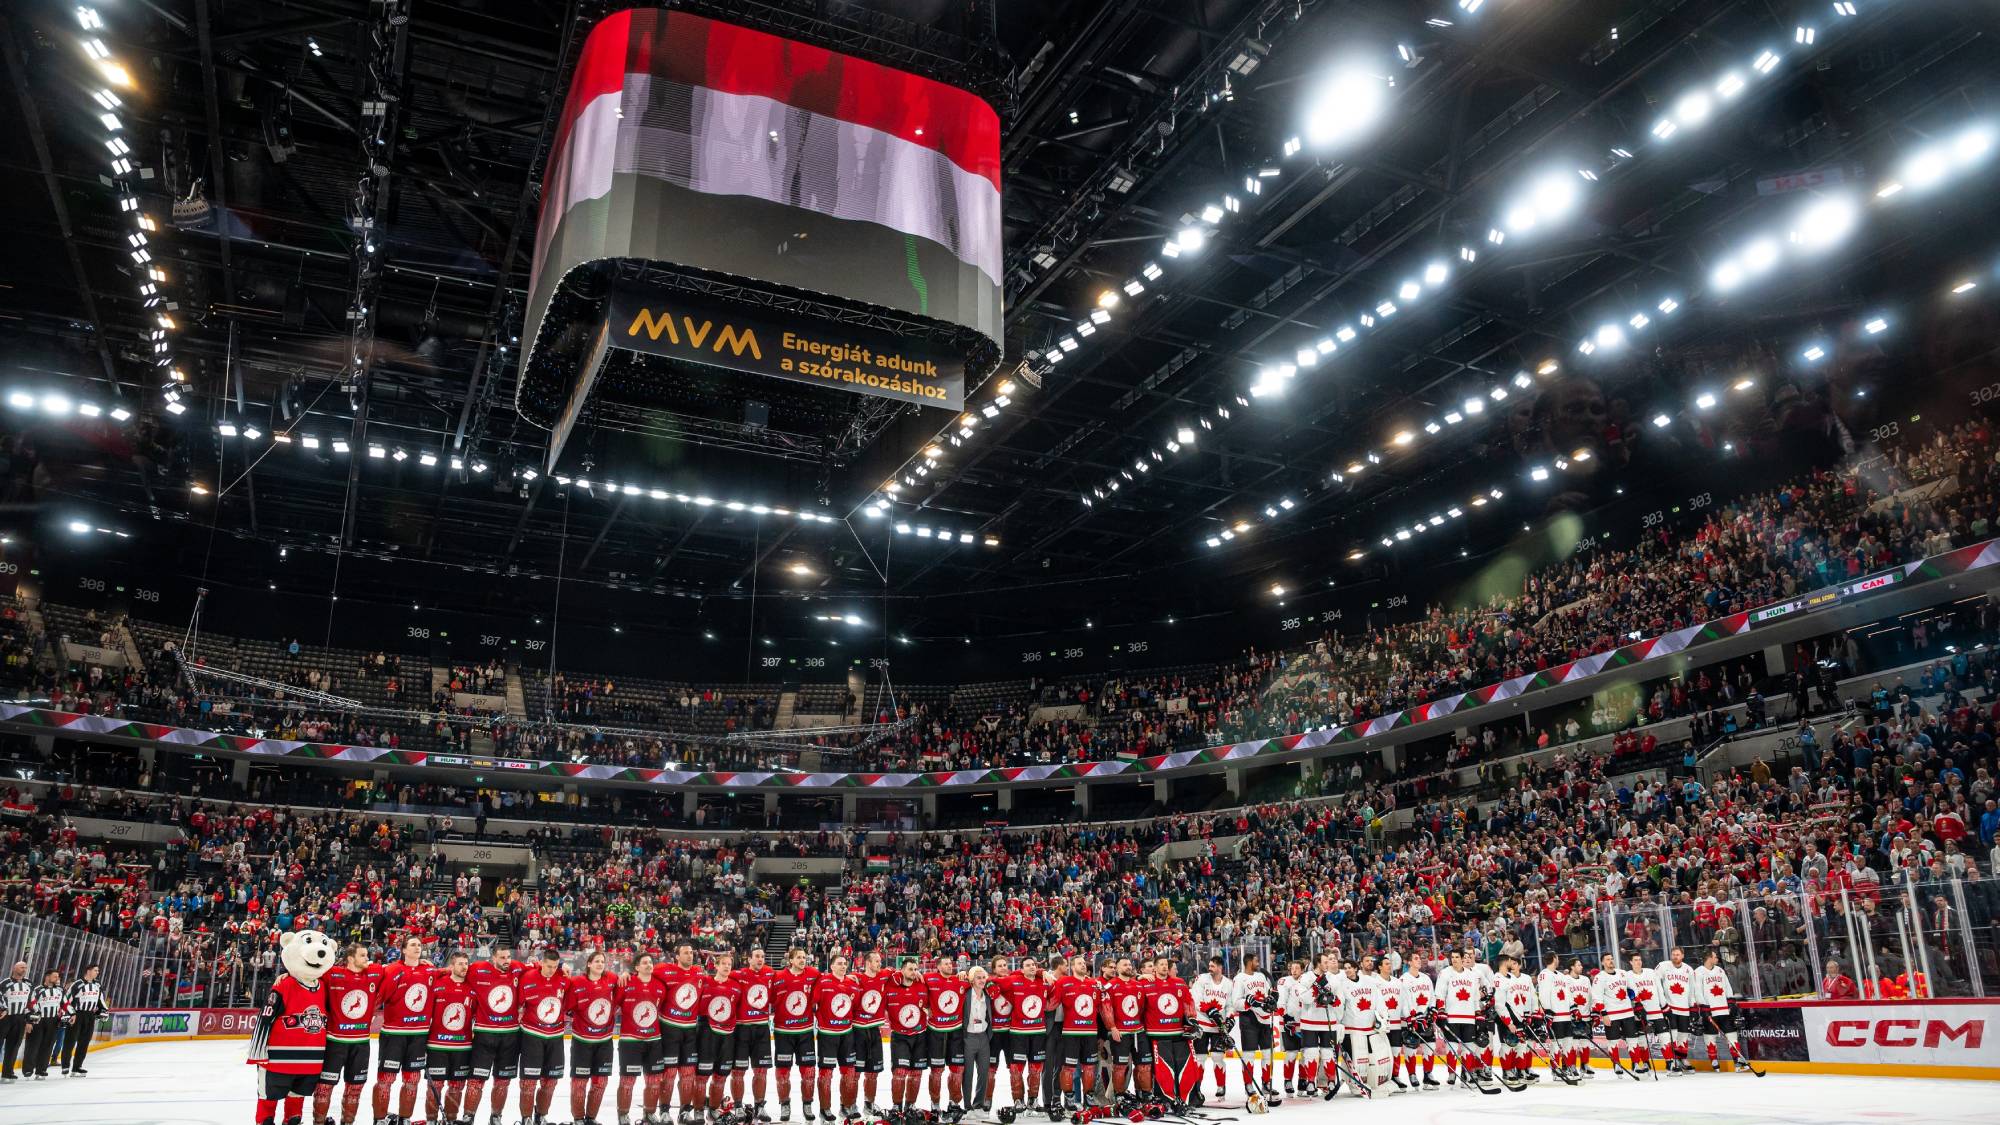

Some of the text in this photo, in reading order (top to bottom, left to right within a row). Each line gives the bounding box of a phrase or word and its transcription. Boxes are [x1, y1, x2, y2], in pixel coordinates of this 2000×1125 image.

[629, 308, 762, 360] MVM
[782, 331, 937, 378] Energiát adunk
[781, 359, 947, 401] a szórakozáshoz
[1969, 382, 2000, 407] 302
[1869, 421, 1899, 443] 303
[1688, 492, 1712, 511] 303
[1641, 510, 1664, 529] 303
[1575, 535, 1596, 553] 304
[78, 577, 105, 592] 308
[134, 588, 160, 602] 308
[1766, 606, 1786, 618] HUN
[1796, 601, 1802, 609] 2
[1861, 578, 1885, 590] CAN
[1386, 594, 1409, 609] 304
[1321, 608, 1343, 623] 304
[1281, 617, 1301, 631] 305
[407, 626, 430, 639] 308
[479, 634, 501, 646] 307
[524, 639, 546, 651] 307
[1063, 647, 1084, 659] 305
[1127, 641, 1148, 653] 305
[762, 657, 782, 667] 307
[804, 657, 825, 667] 306
[1021, 651, 1042, 663] 306
[111, 824, 132, 835] 207
[473, 849, 492, 860] 206
[791, 861, 808, 870] 205
[1667, 974, 1689, 983] CANADA
[1705, 976, 1723, 985] CANADA
[1246, 980, 1265, 990] CANADA
[1569, 985, 1589, 994] CANADA
[1205, 988, 1228, 1000] CANADA
[1350, 987, 1372, 998] CANADA
[262, 1005, 274, 1017] 10
[1826, 1019, 1985, 1049] CCM
